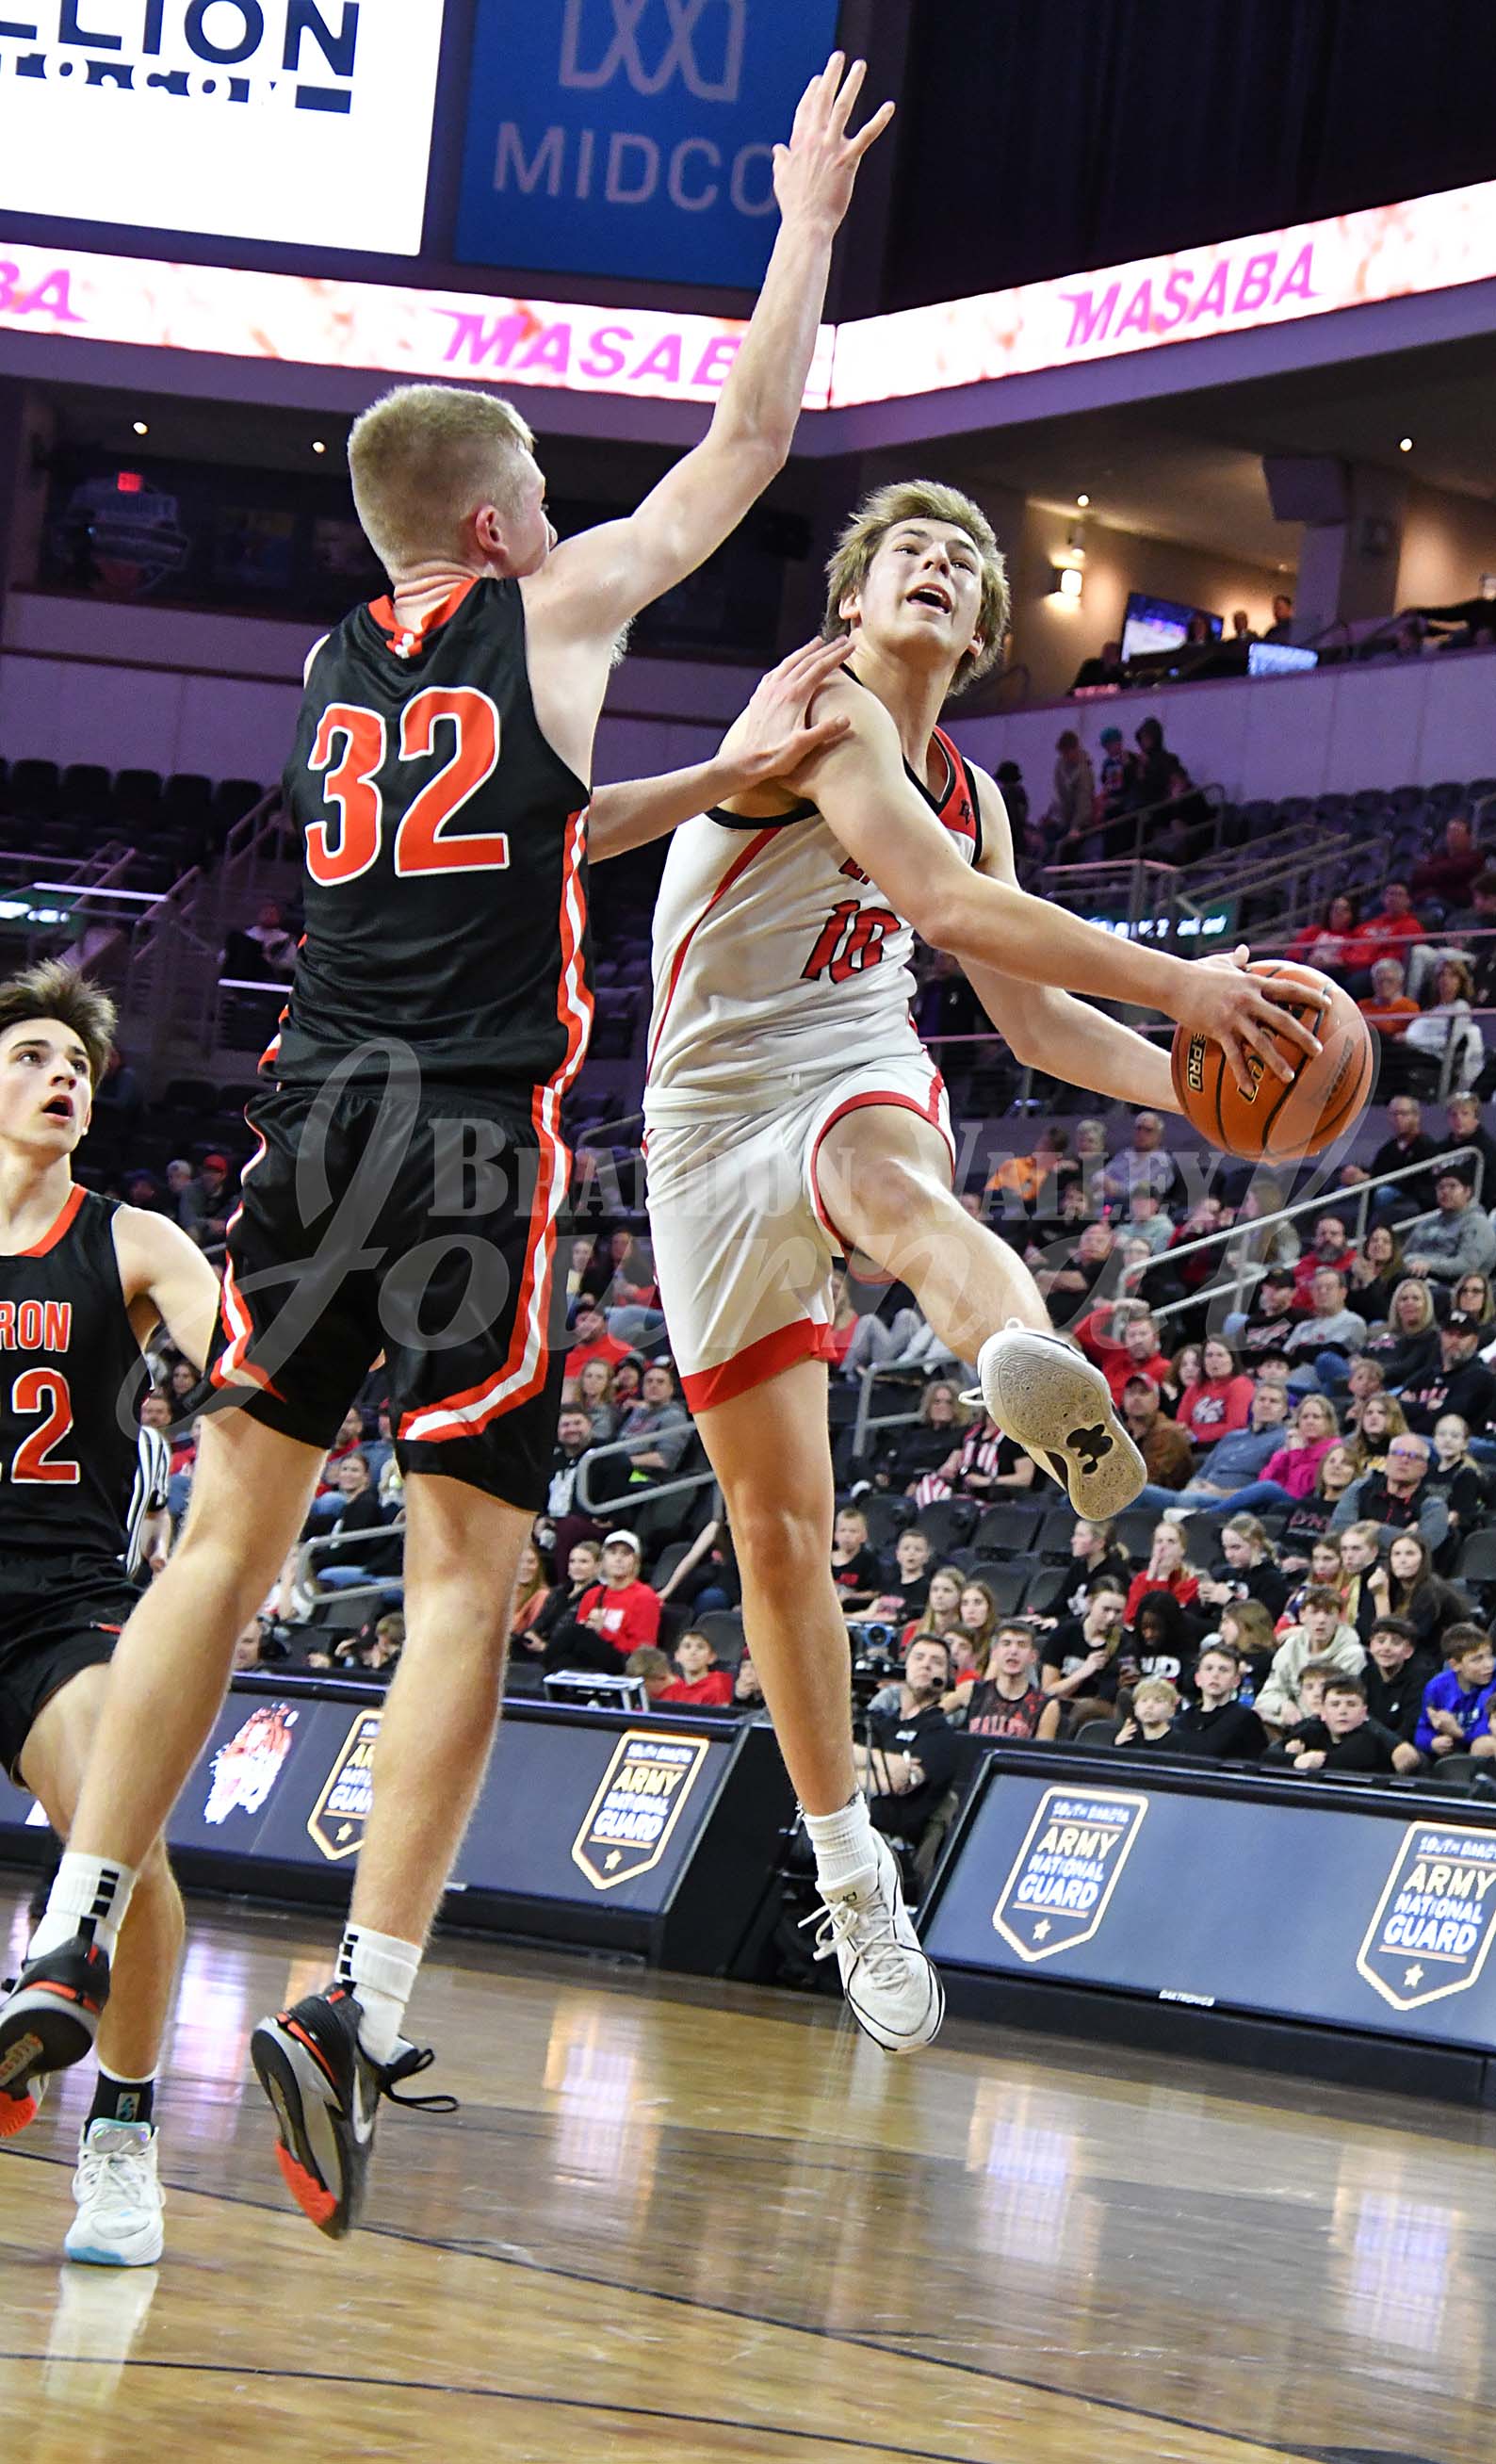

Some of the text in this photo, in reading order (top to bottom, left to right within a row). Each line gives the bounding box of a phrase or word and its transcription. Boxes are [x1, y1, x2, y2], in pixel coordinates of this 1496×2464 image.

[0, 0, 359, 76] LION
[494, 122, 778, 217] MIDCO
[1057, 241, 1325, 349] MASABA
[431, 307, 744, 388] MASAB
[304, 686, 511, 887] 32
[0, 1366, 80, 1484] 2
[612, 1765, 684, 1797] ARMY
[593, 1808, 665, 1842] GUARD
[1036, 1826, 1120, 1861] ARMY
[1027, 1853, 1105, 1883] NATIONAL
[1402, 1862, 1496, 1901] ARMY
[1016, 1873, 1099, 1910] GUARD
[1393, 1893, 1484, 1924] NATIONAL
[1383, 1914, 1478, 1954] GUARD
